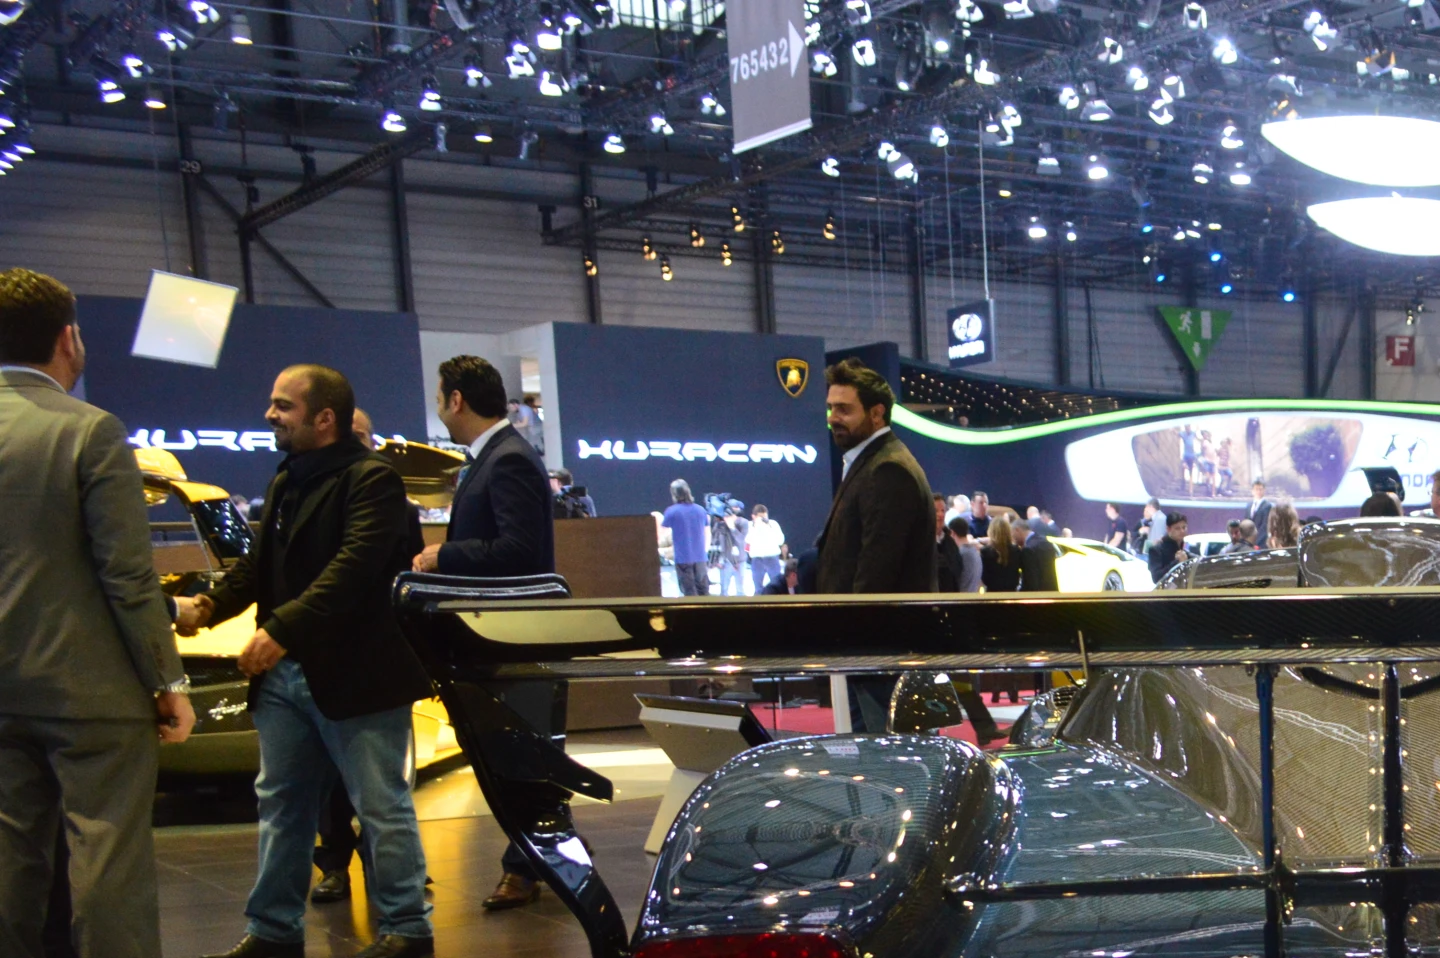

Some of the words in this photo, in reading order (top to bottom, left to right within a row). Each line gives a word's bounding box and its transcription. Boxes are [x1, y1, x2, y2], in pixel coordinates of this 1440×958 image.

[730, 37, 789, 84] 765432
[583, 195, 598, 208] 31
[1394, 337, 1410, 360] F
[578, 438, 817, 464] HURACAN
